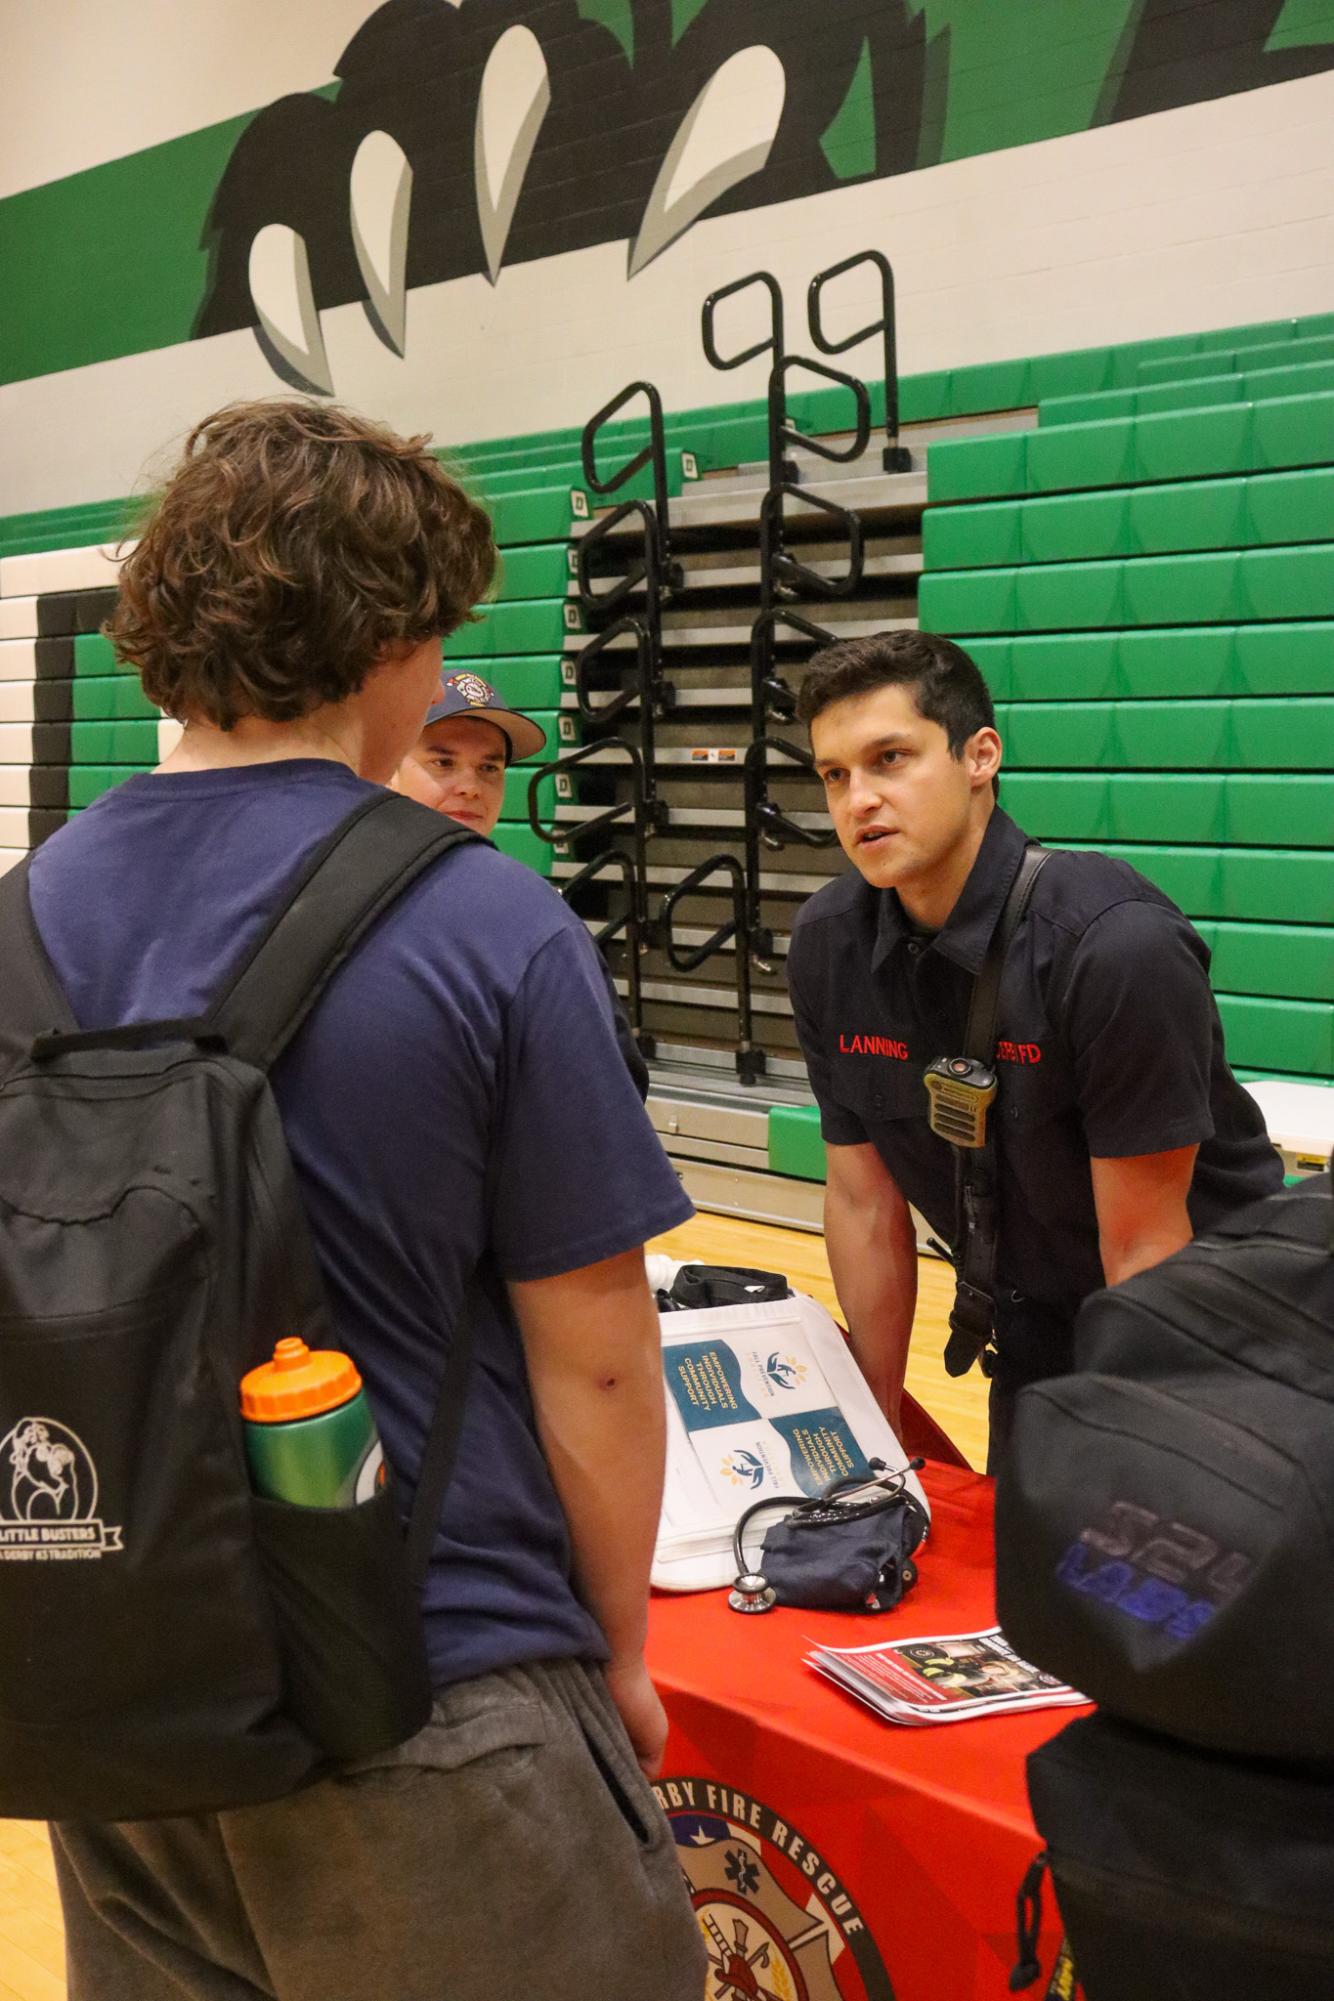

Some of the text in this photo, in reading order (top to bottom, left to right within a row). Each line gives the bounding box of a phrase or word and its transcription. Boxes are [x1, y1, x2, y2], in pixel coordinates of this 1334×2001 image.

[839, 1034, 908, 1061] LANNING
[677, 1366, 699, 1406] SUPPORT
[684, 1358, 711, 1410] COMMUNITY
[696, 1362, 717, 1404] THROUGH
[702, 1355, 729, 1409] INDIVIDUALS
[709, 1352, 738, 1409] EMPOWERING
[813, 1433, 837, 1473] THROUGH
[818, 1425, 849, 1476] COMMUNITY
[830, 1429, 854, 1468] SUPPORT
[41, 1527, 96, 1541] BUSTERS
[706, 1785, 763, 1829] FIRE
[772, 1820, 864, 1935] RESCUE
